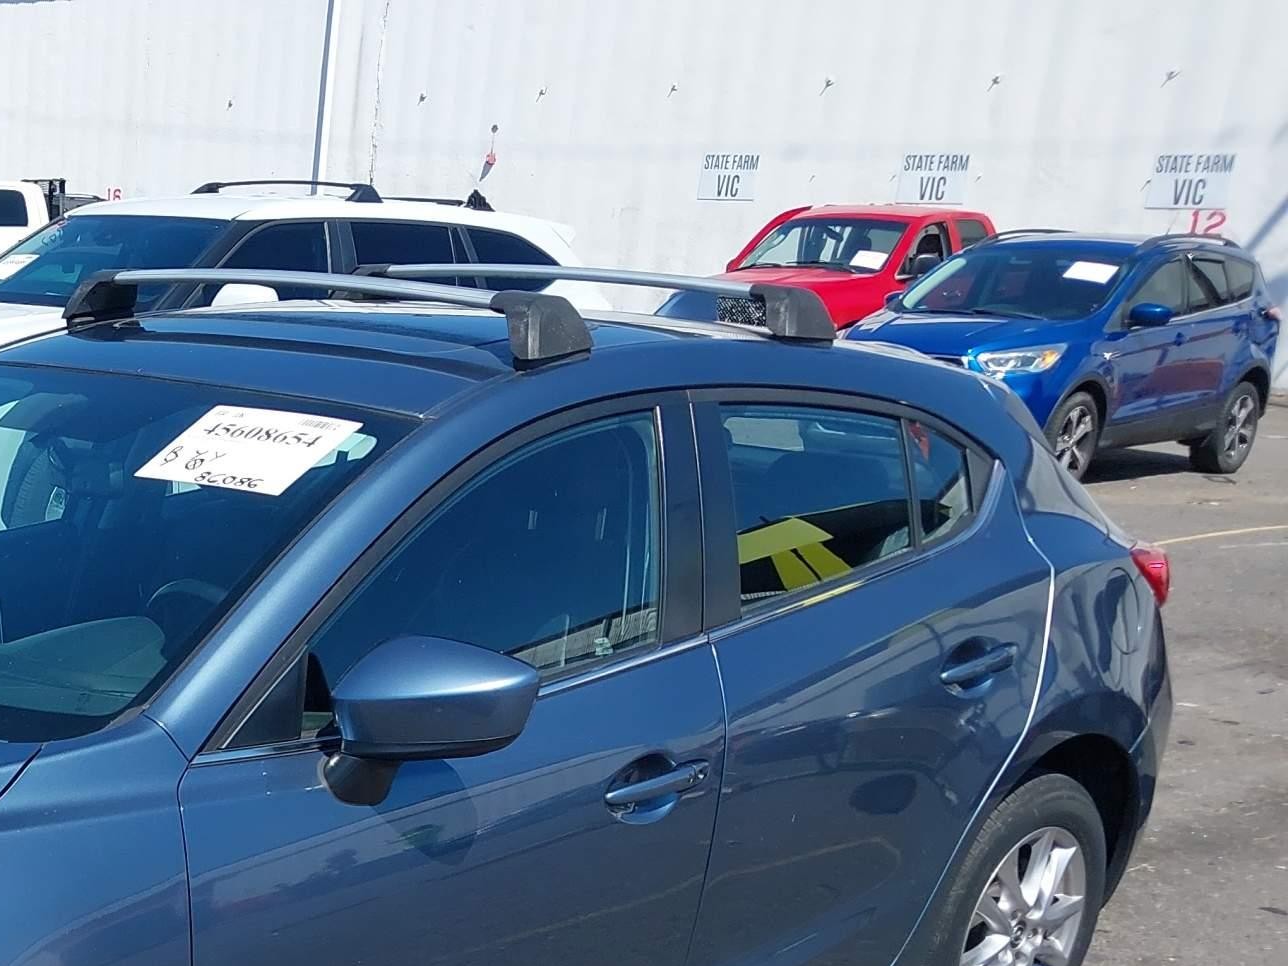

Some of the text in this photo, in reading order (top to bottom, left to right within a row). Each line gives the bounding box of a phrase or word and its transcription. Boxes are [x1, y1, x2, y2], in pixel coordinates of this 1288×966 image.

[704, 154, 760, 170] STATE FARM
[904, 154, 970, 171] STATE FARM
[1156, 154, 1236, 173] STATE FARM
[717, 174, 740, 197] VIC
[919, 176, 947, 201] VIC
[1173, 179, 1206, 205] VIC
[1190, 209, 1226, 234] 12
[204, 422, 323, 448] 45608654
